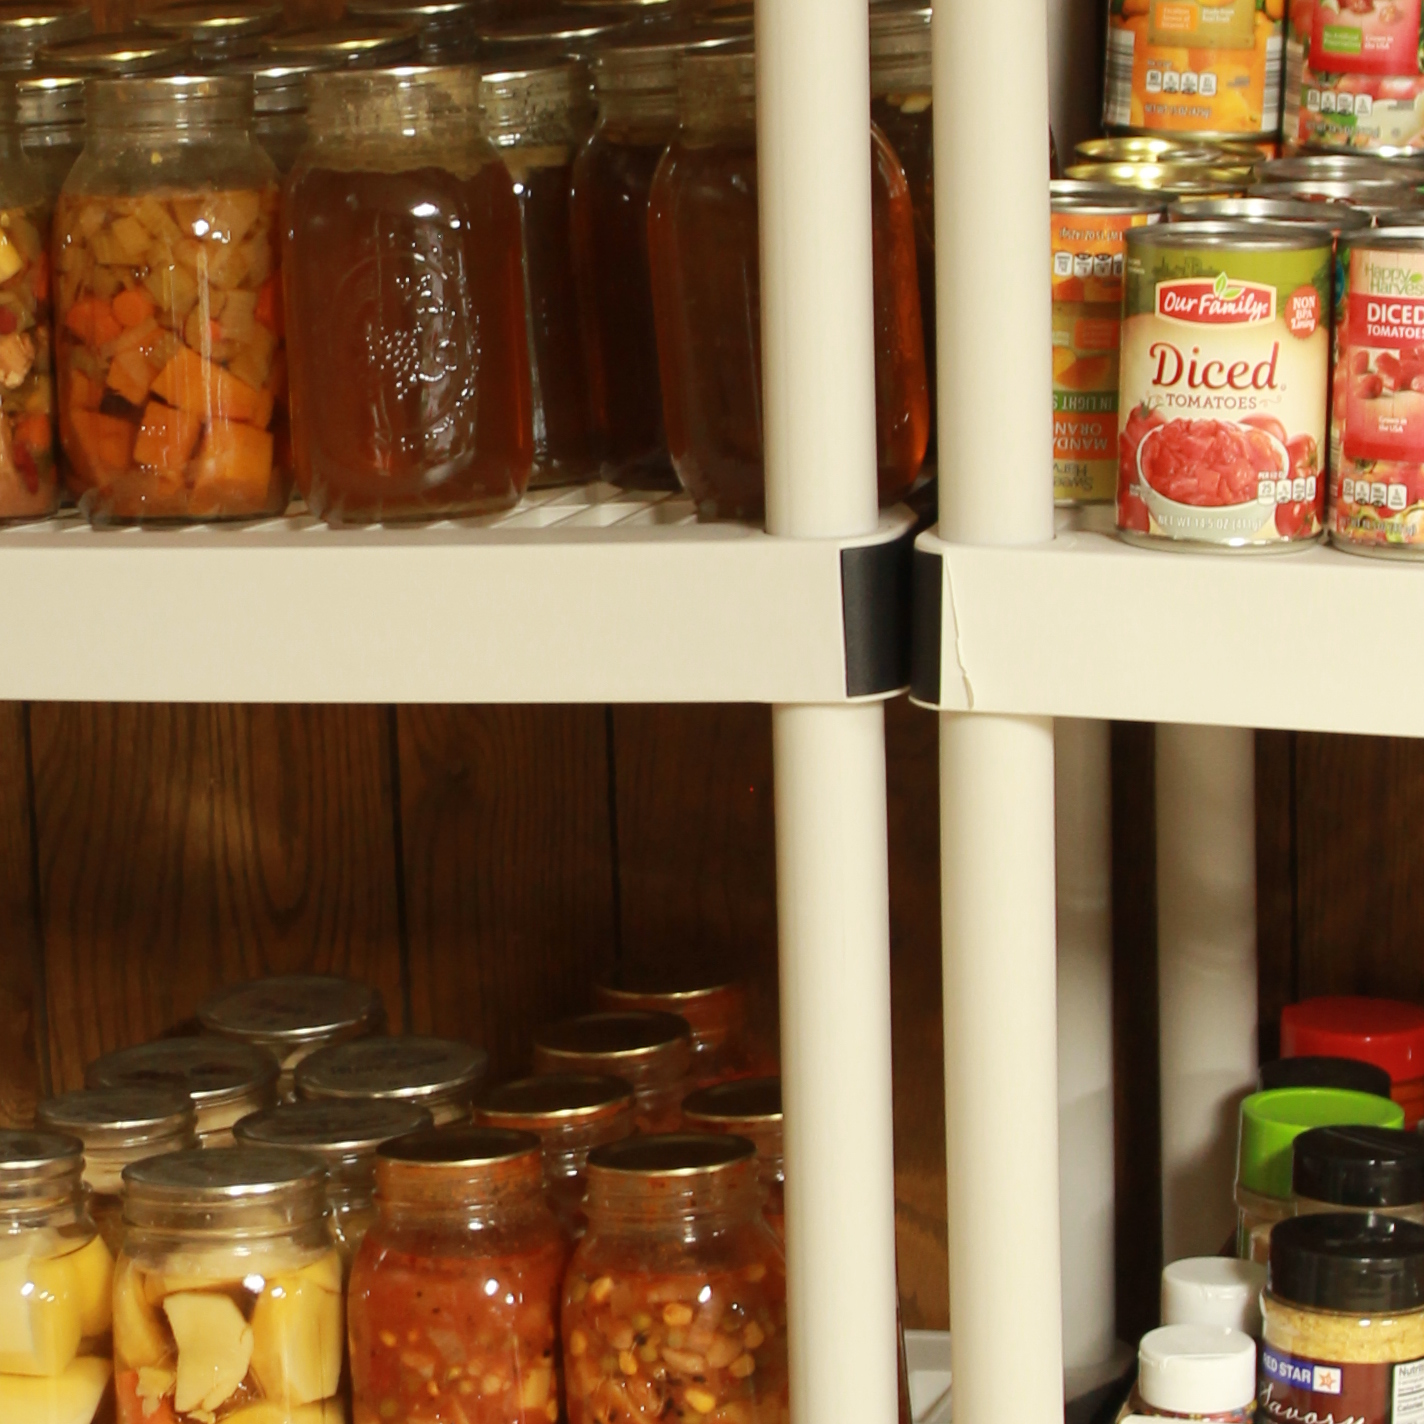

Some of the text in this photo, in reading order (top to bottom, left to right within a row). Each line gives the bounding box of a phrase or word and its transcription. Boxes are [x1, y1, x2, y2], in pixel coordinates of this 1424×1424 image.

[1164, 292, 1262, 322] Our Family
[1293, 296, 1315, 310] NON
[1296, 309, 1312, 320] BPA
[1367, 302, 1424, 325] DICED
[1149, 340, 1279, 390] Diced
[1166, 394, 1257, 410] TOMATOES
[1053, 421, 1102, 436] ORAN
[1279, 1362, 1311, 1384] STAR
